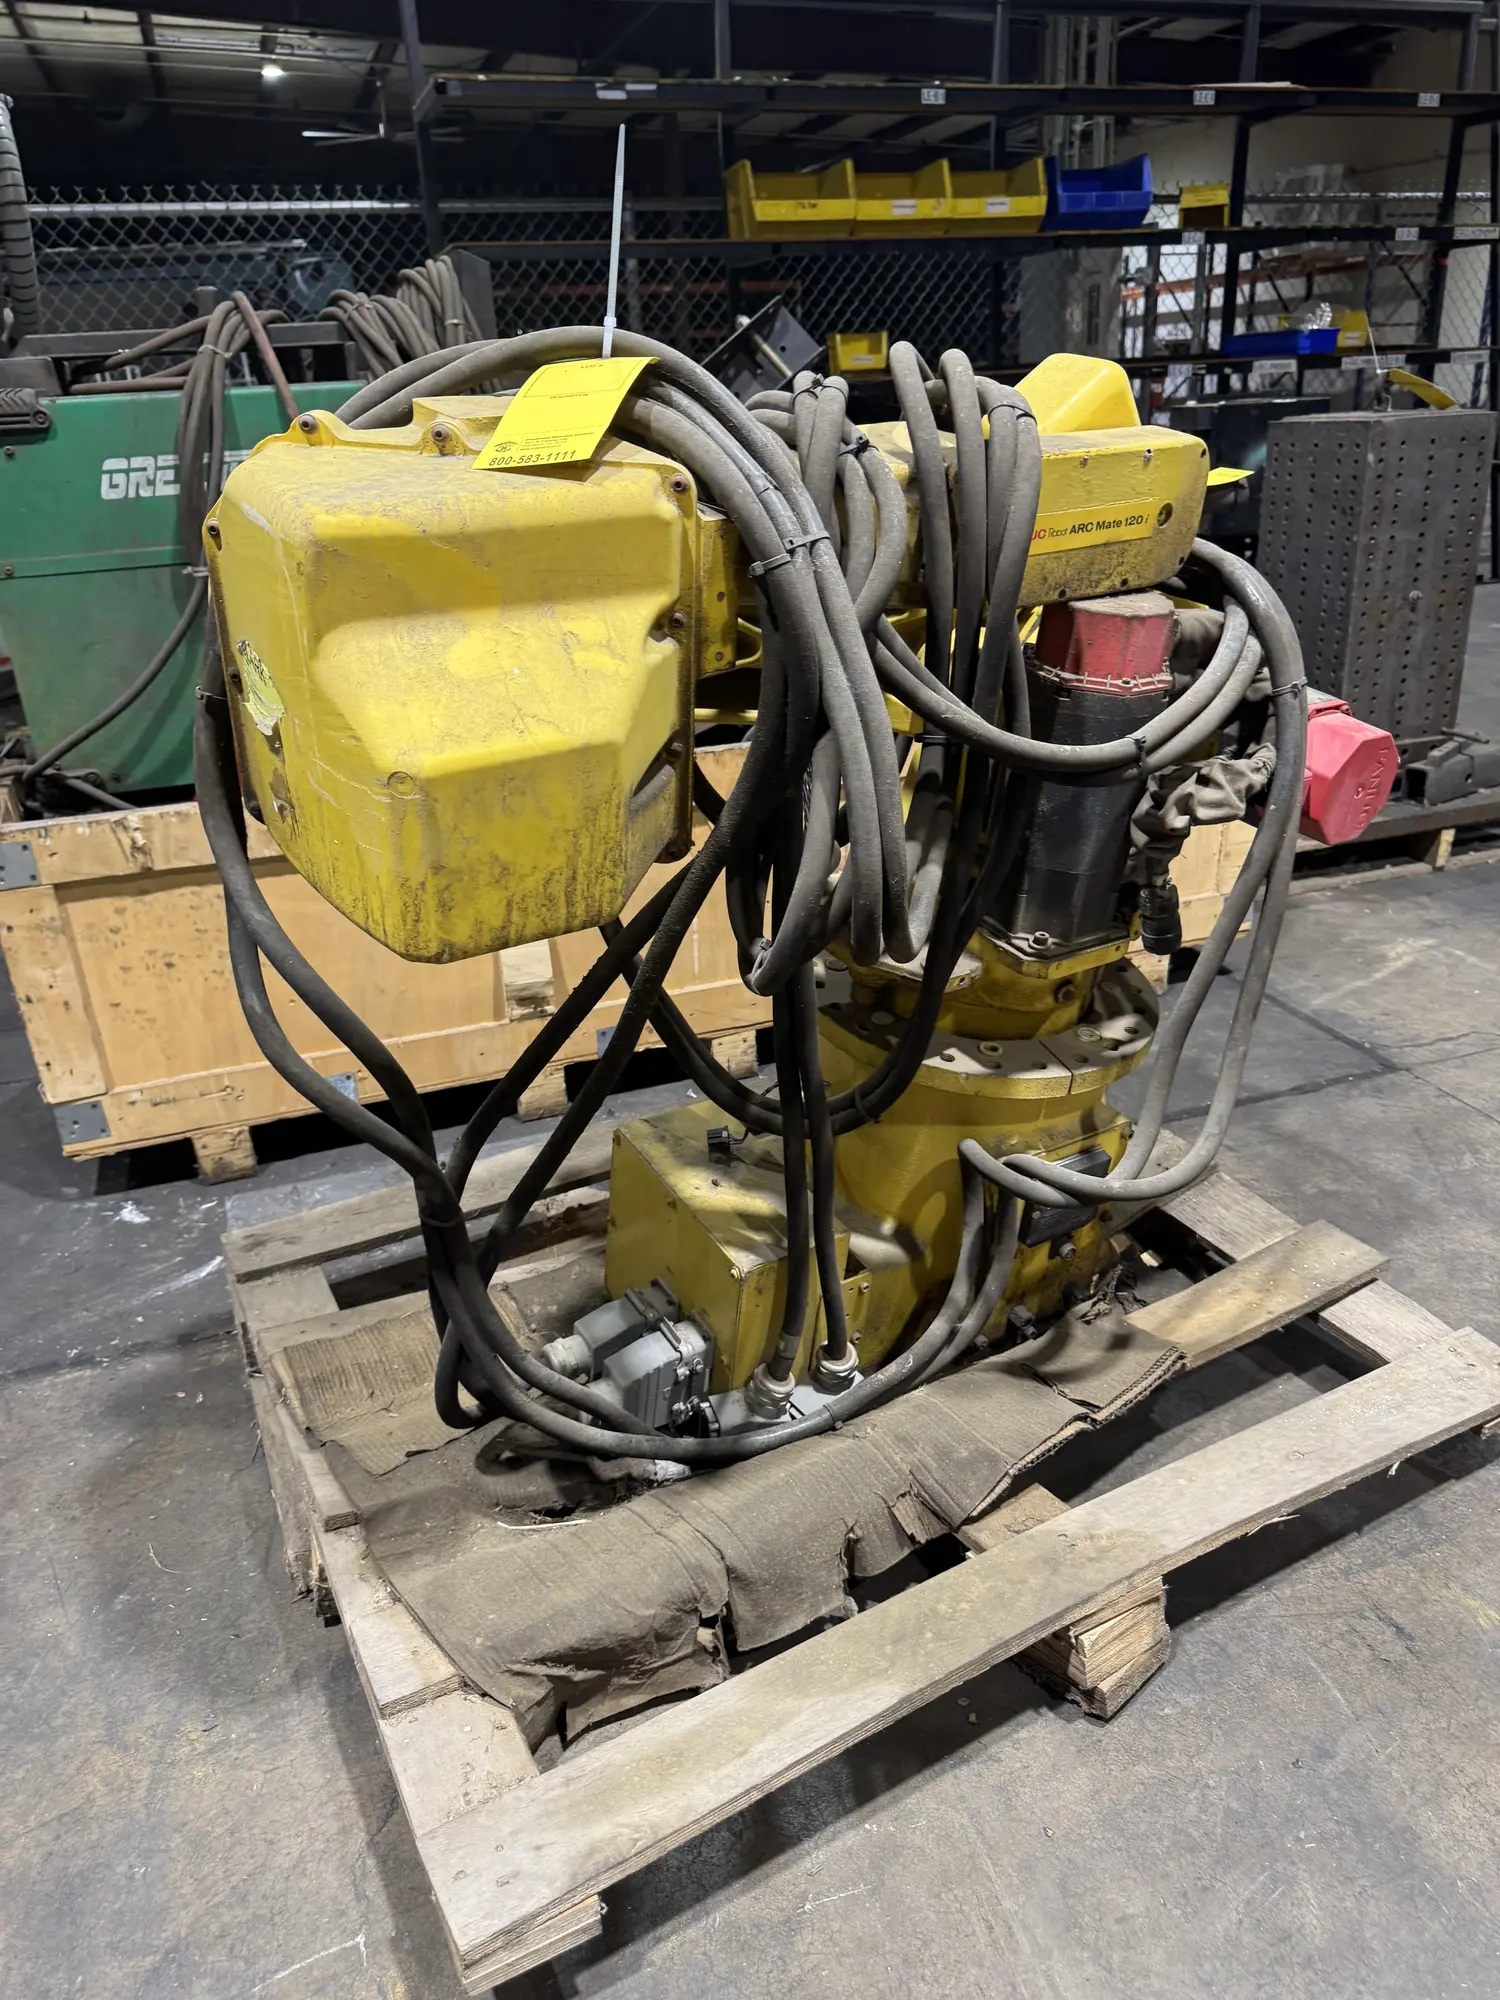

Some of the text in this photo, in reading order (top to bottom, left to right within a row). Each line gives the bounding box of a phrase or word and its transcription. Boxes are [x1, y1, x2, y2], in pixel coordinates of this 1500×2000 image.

[488, 449, 577, 466] 800-583-1111
[1048, 527, 1068, 538] Robot
[1069, 522, 1094, 535] ARC
[1095, 518, 1122, 531] Mate
